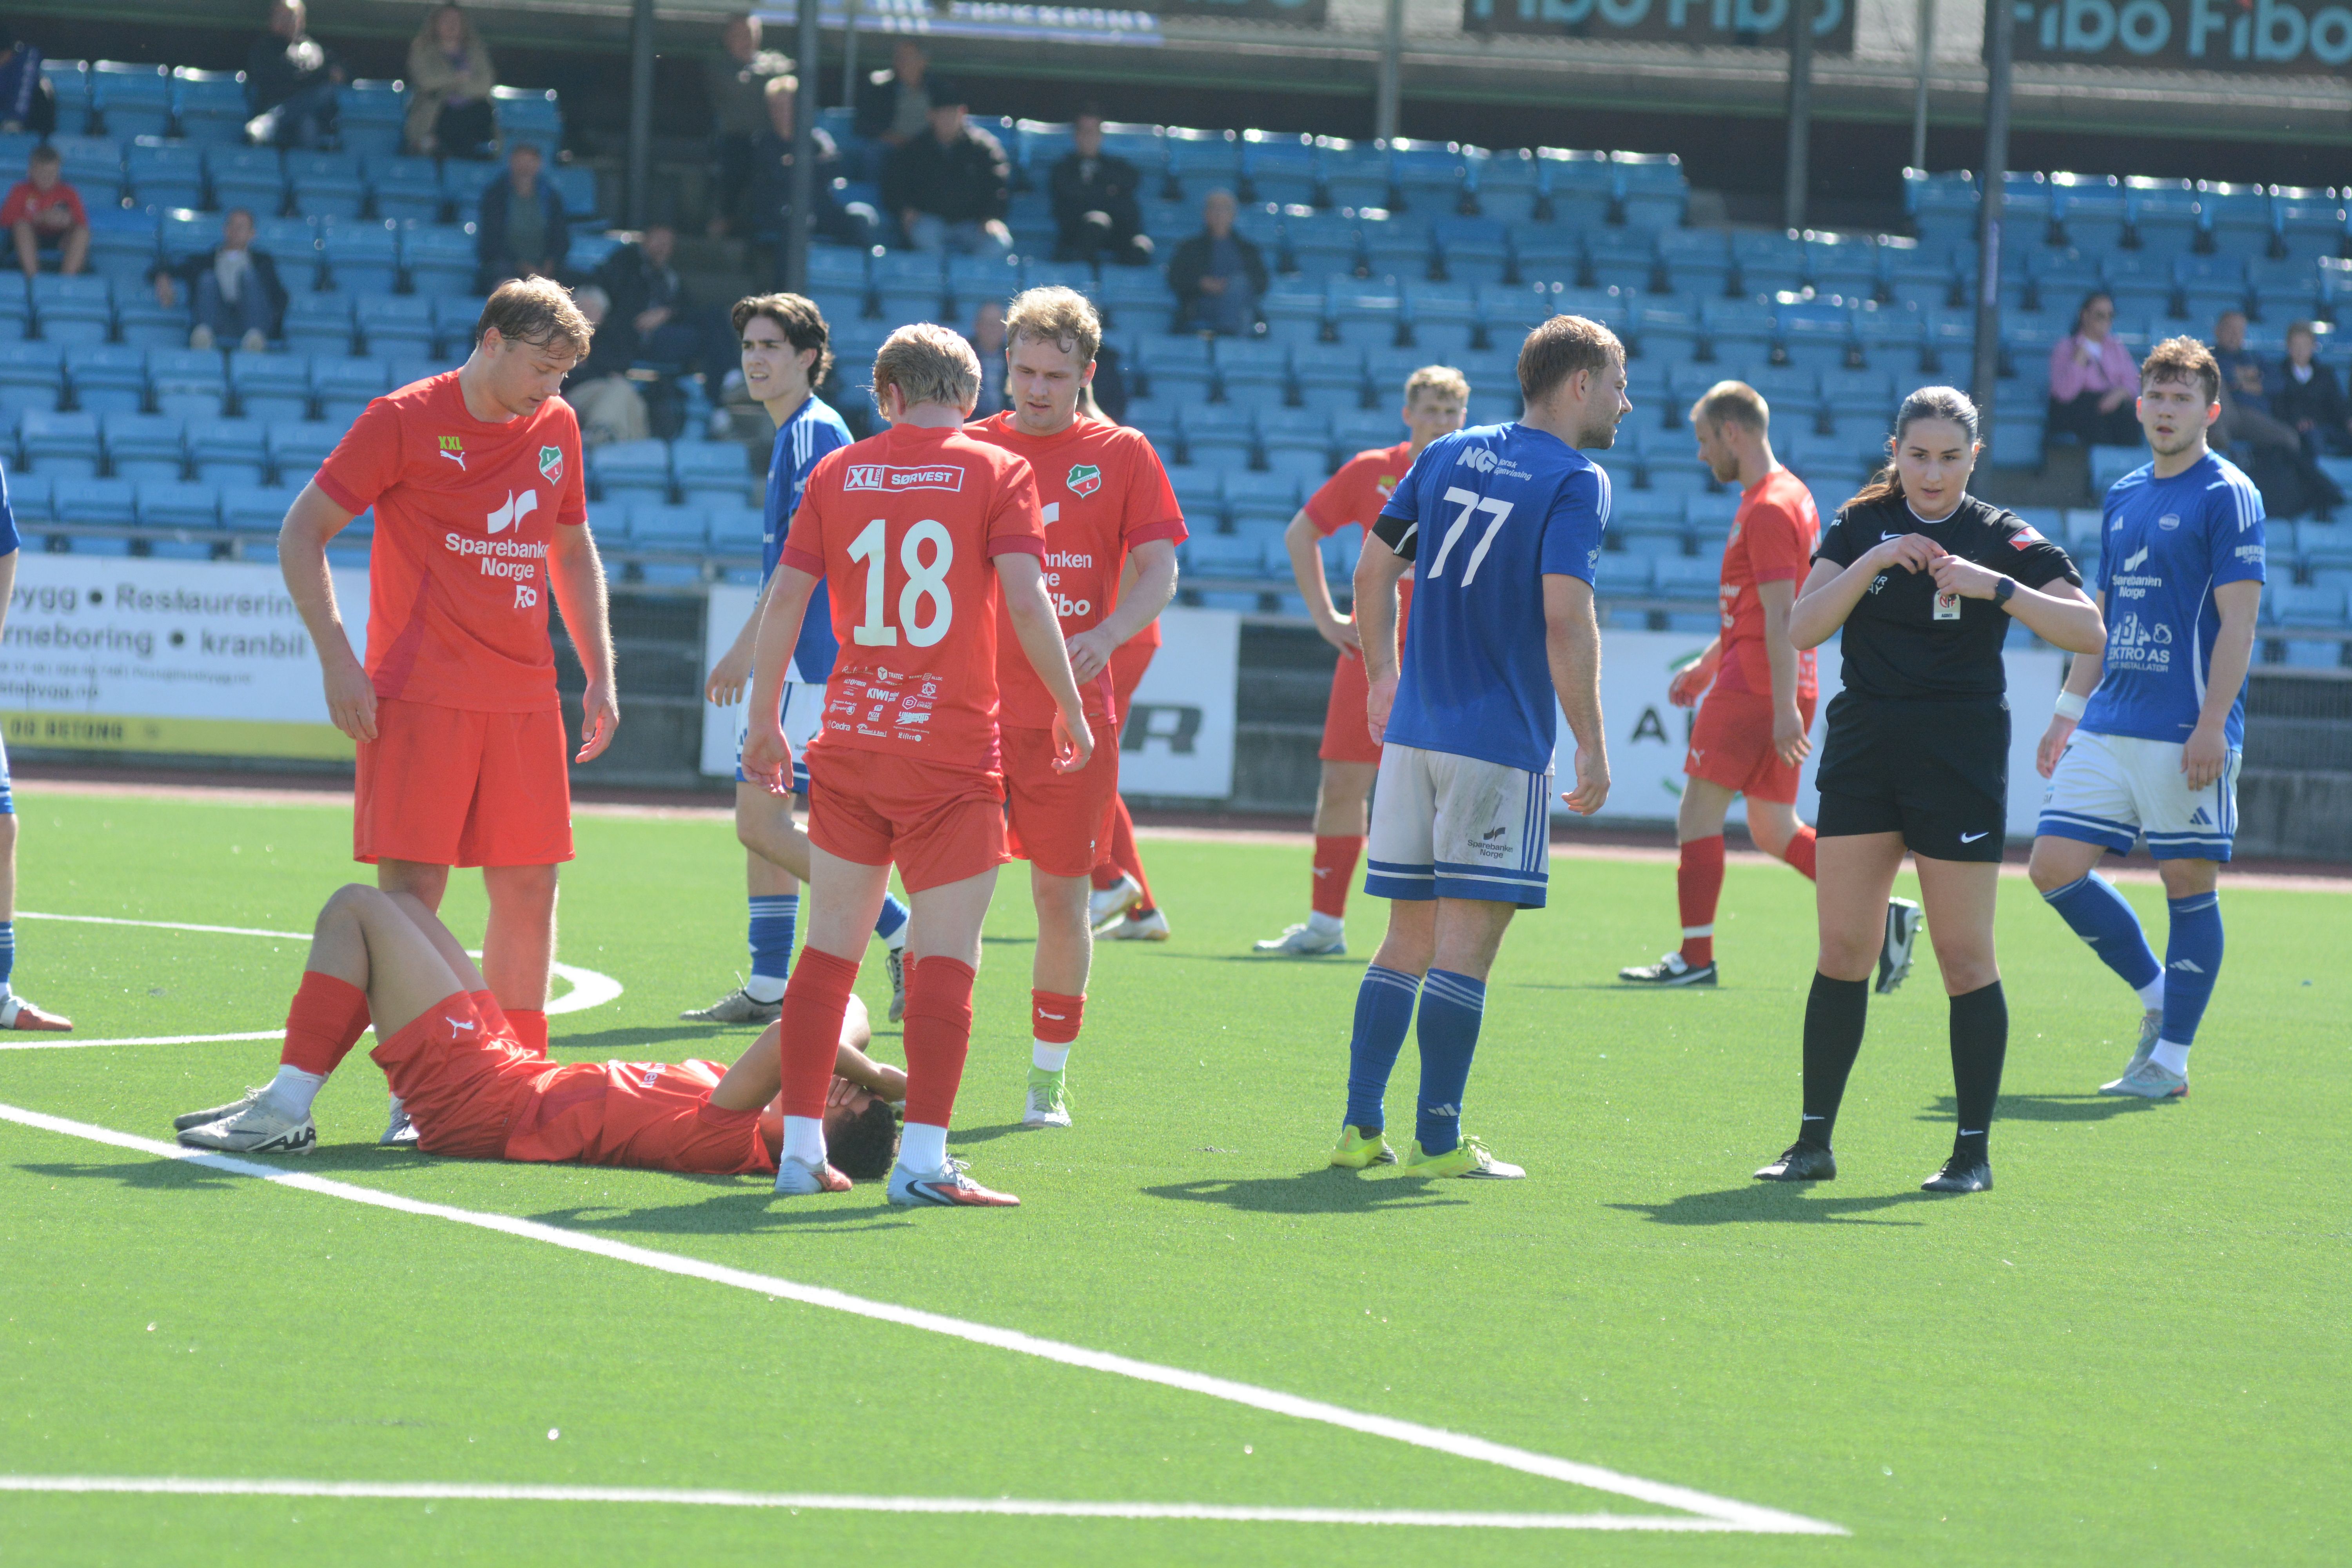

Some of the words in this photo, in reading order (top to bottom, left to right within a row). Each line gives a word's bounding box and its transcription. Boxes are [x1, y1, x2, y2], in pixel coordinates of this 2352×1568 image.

[438, 436, 463, 450] XXL
[1456, 446, 1498, 474] NG
[847, 468, 879, 487] XL
[891, 472, 953, 485] SØRVEST
[1074, 475, 1093, 485] LYNGDAL
[1494, 467, 1532, 481] Gjenvinning
[1427, 486, 1514, 588] 77
[445, 533, 550, 559] Sparebank
[481, 557, 535, 582] Norge
[847, 519, 953, 647] 18
[116, 581, 301, 620] Restaurerin
[1, 622, 154, 661] rneboring
[200, 629, 307, 658] kranbil
[2147, 648, 2171, 664] AS
[866, 688, 889, 701] KIWI
[831, 721, 851, 731] Cedra
[1467, 839, 1513, 853] Sparebanken
[1480, 849, 1503, 859] Norge
